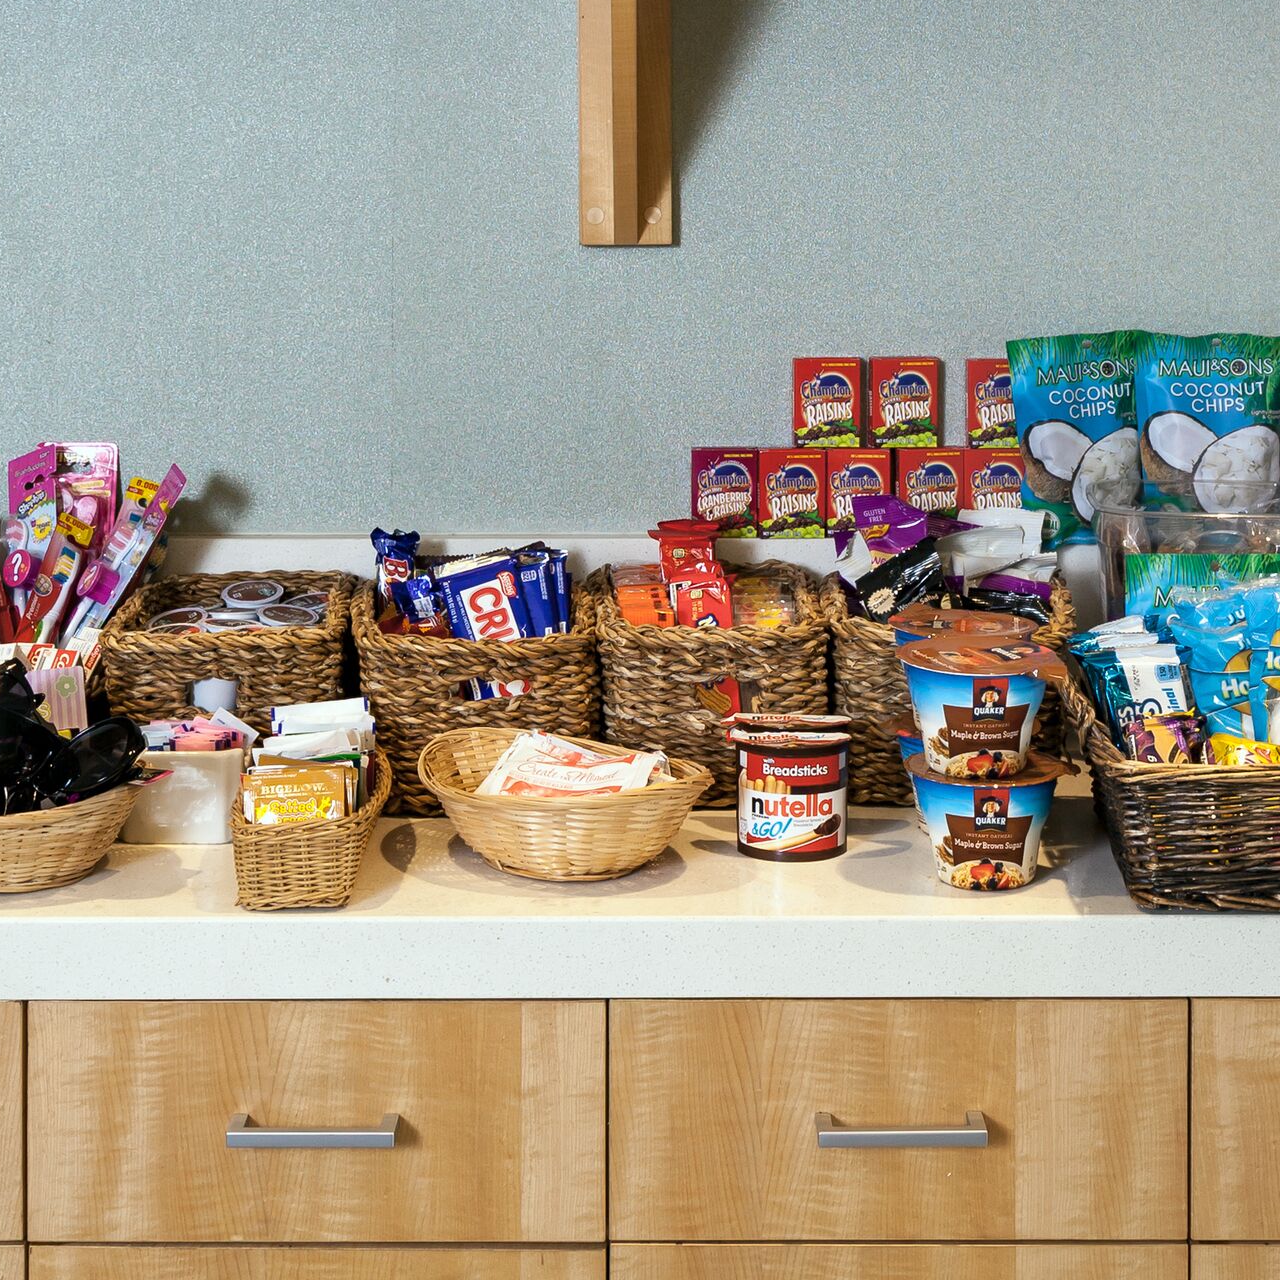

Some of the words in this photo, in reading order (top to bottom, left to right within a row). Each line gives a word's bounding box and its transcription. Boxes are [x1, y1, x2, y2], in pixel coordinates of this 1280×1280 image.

[802, 381, 852, 400] Champion
[880, 380, 929, 399] Champion
[1049, 382, 1132, 406] COCONUT
[1170, 381, 1265, 397] COCONUT
[807, 401, 853, 428] RAISINS
[885, 400, 931, 428] RAISINS
[1069, 399, 1117, 419] CHIPS
[1191, 398, 1245, 413] CHIPS
[699, 470, 749, 488] Champion
[767, 472, 816, 491] Champion
[831, 472, 880, 491] Champion
[907, 470, 955, 488] Champion
[697, 491, 752, 513] CRANBERRIES
[713, 502, 747, 518] RAISINS
[772, 494, 818, 521] RAISINS
[863, 508, 886, 517] GLUTEN
[973, 706, 1005, 716] QUAKER
[950, 729, 972, 740] Maple
[972, 729, 980, 740] &
[980, 730, 1002, 740] Brown
[1003, 729, 1020, 740] Sugar
[762, 763, 828, 777] Breadsticks
[751, 794, 833, 818] nutella
[751, 817, 793, 839] &GO!
[975, 816, 1007, 826] QUAKER
[954, 838, 974, 850] Maple
[975, 839, 982, 850] &
[982, 841, 1004, 850] Brown
[1004, 841, 1022, 851] Sugar
